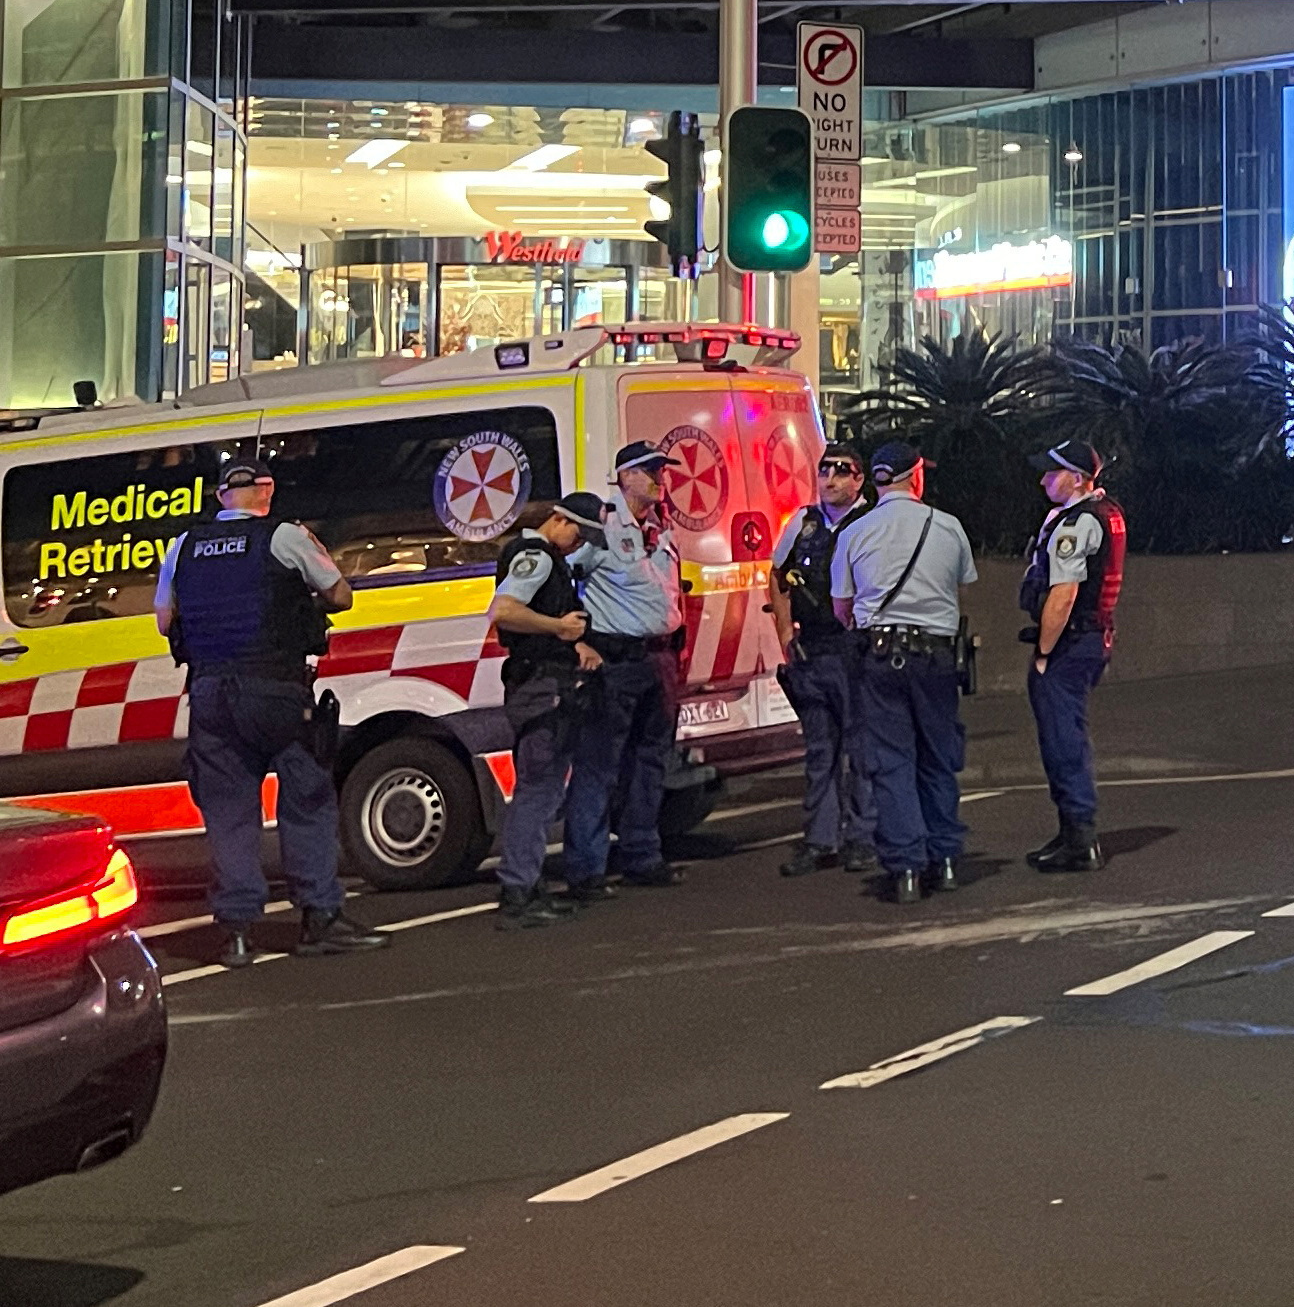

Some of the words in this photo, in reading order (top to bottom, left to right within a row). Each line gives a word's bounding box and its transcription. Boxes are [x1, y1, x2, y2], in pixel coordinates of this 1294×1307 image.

[813, 90, 846, 112] NO
[812, 118, 854, 133] IGHT
[815, 136, 852, 152] URN
[817, 171, 849, 183] USES
[816, 186, 855, 199] CEPTED
[816, 216, 856, 229] CYCLES
[485, 230, 588, 263] Westfield
[437, 446, 460, 478] NEW
[459, 432, 501, 452] SOUTH
[501, 434, 530, 473] WALES
[51, 476, 204, 531] Medical
[39, 533, 177, 580] Retriev
[193, 540, 246, 558] POLICE
